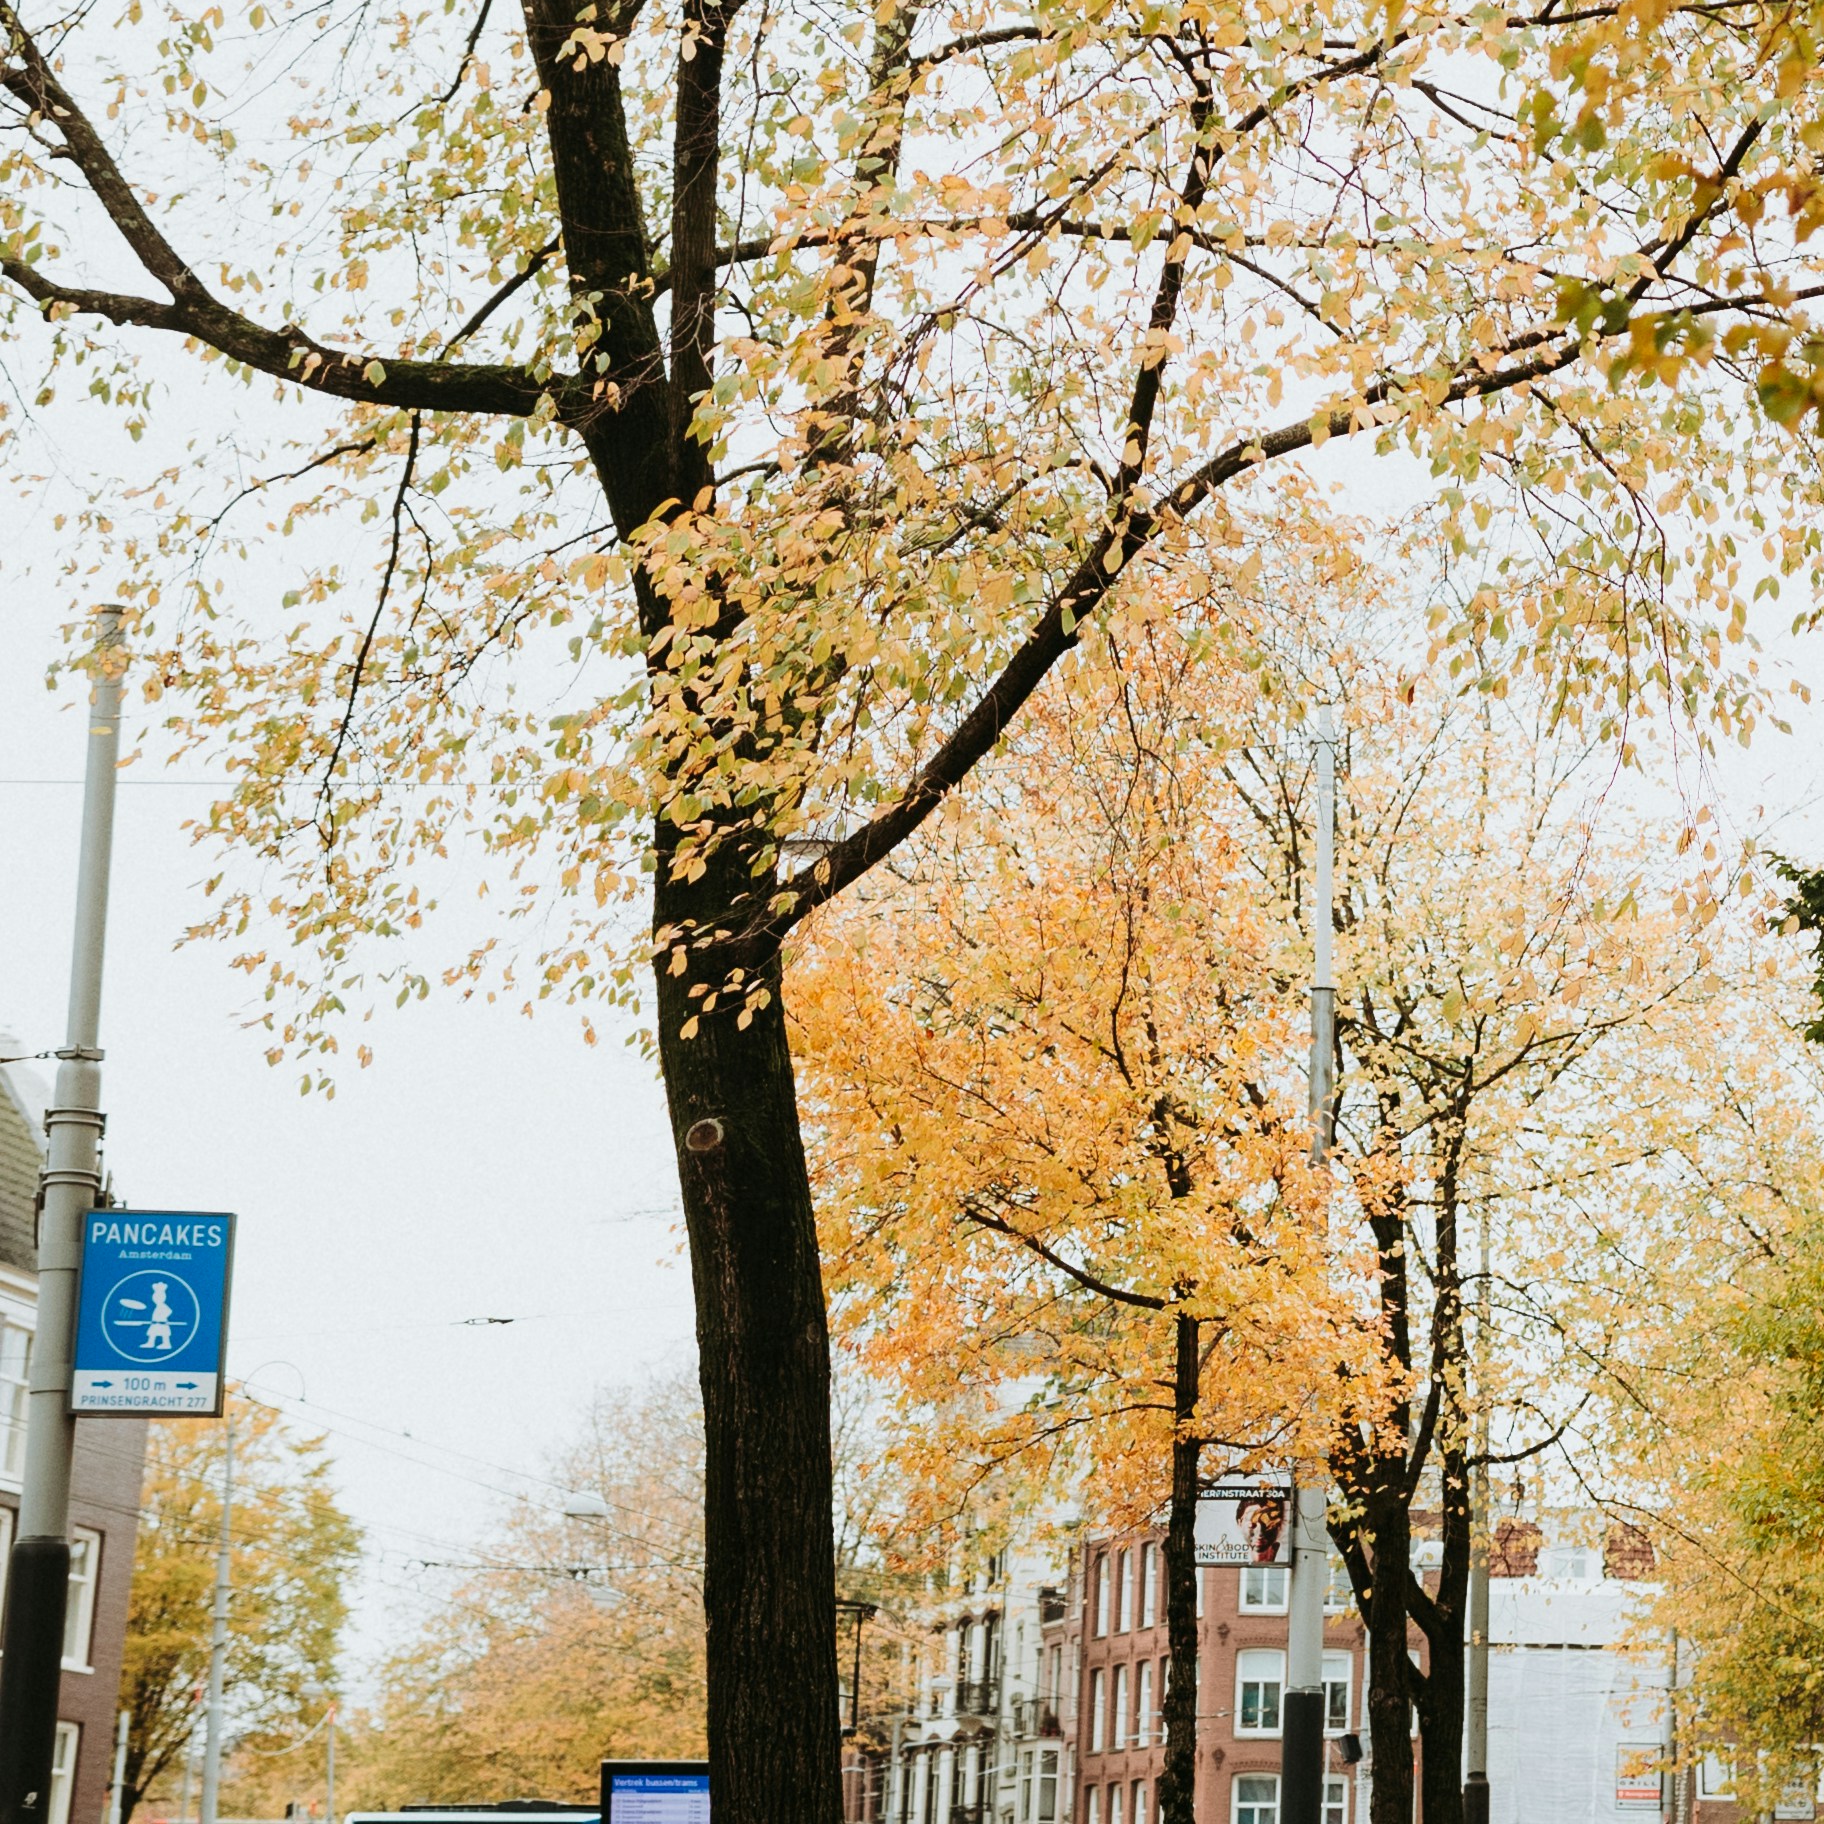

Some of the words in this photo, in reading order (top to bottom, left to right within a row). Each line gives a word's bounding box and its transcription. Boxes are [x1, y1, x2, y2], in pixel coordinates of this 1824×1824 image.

[91, 1222, 222, 1247] PANCAKES
[118, 1250, 192, 1260] Amsterdam
[124, 1378, 150, 1391] 100
[155, 1381, 166, 1391] m
[81, 1395, 183, 1407] PRINSENGRACHT
[187, 1396, 207, 1408] 277
[614, 1778, 643, 1786] Vertrek
[645, 1778, 698, 1786] bussen/trams
